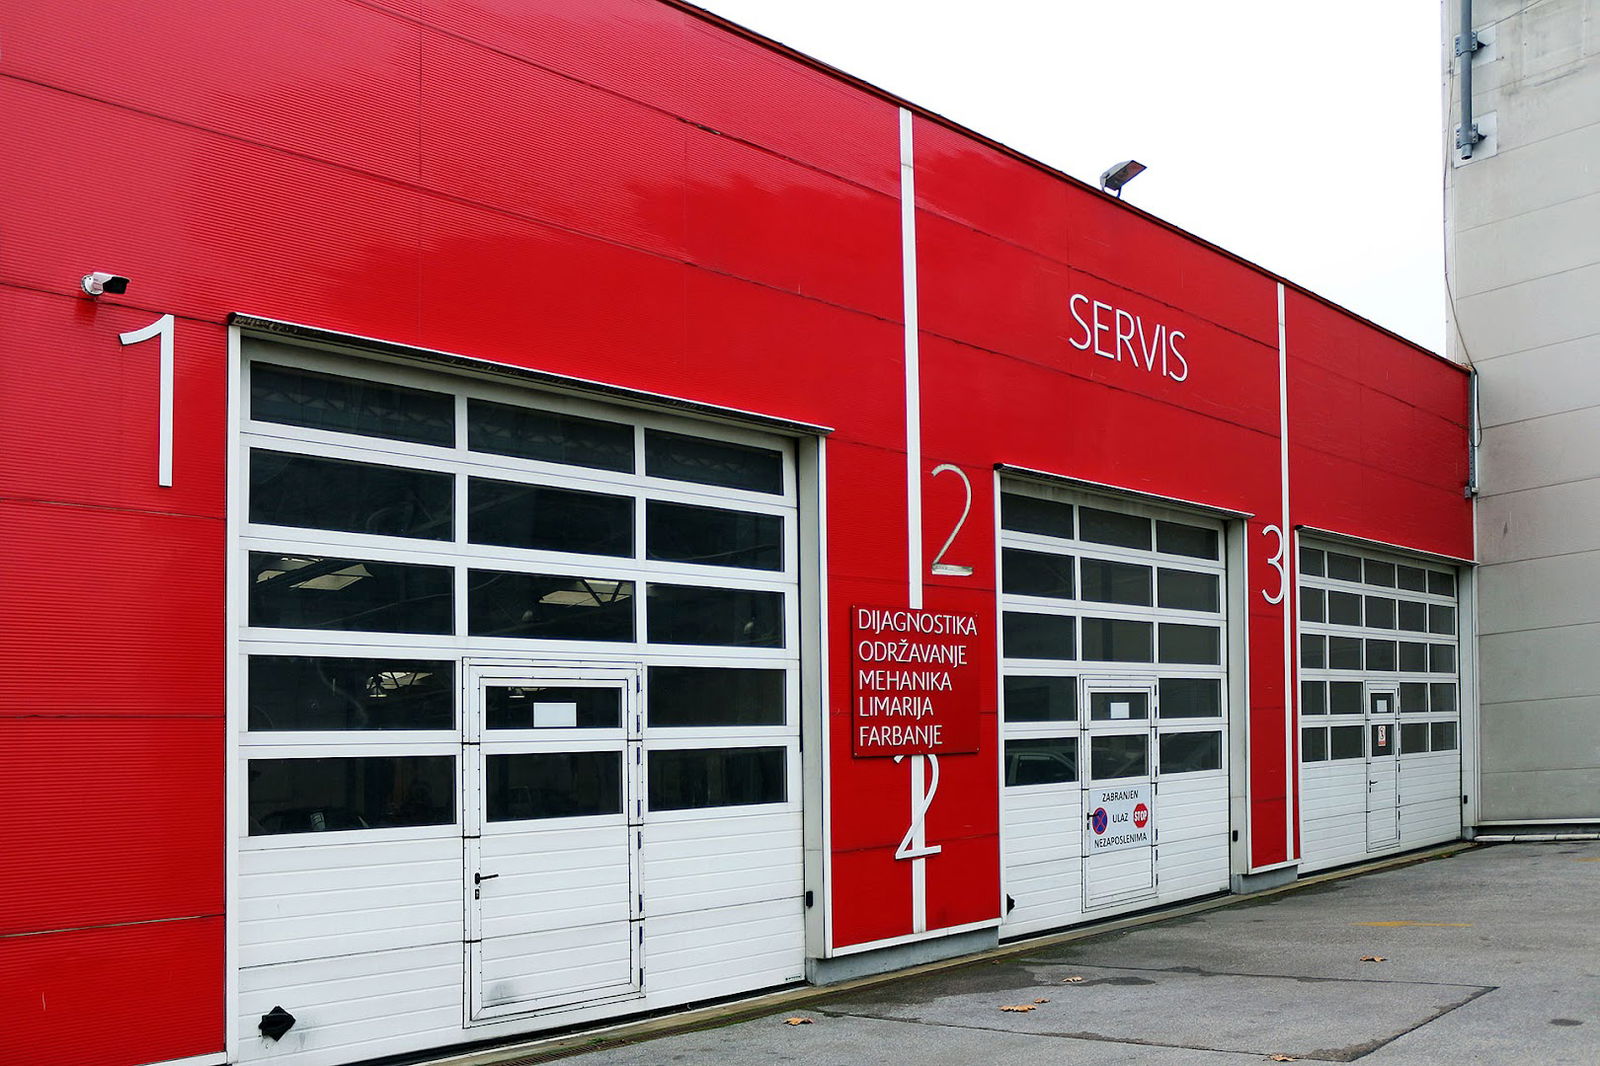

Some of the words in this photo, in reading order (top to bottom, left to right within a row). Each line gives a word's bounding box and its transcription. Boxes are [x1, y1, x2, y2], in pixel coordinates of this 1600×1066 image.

[1068, 293, 1188, 382] SERVIS
[119, 313, 175, 487] 1
[931, 463, 973, 577] 2
[1261, 524, 1284, 605] 3
[858, 608, 978, 636] DIJAGNOSTIKA
[858, 639, 967, 668] ODRŽAVANJE
[859, 669, 953, 691] MEHANIKA
[859, 696, 934, 720] LIMARIJA
[859, 724, 943, 748] FARBANJE
[1102, 790, 1138, 802] ZABRANJEN
[1112, 813, 1128, 823] ULAZ
[1134, 810, 1147, 822] STOP
[1094, 832, 1147, 848] NEZAPOSLENIMA
